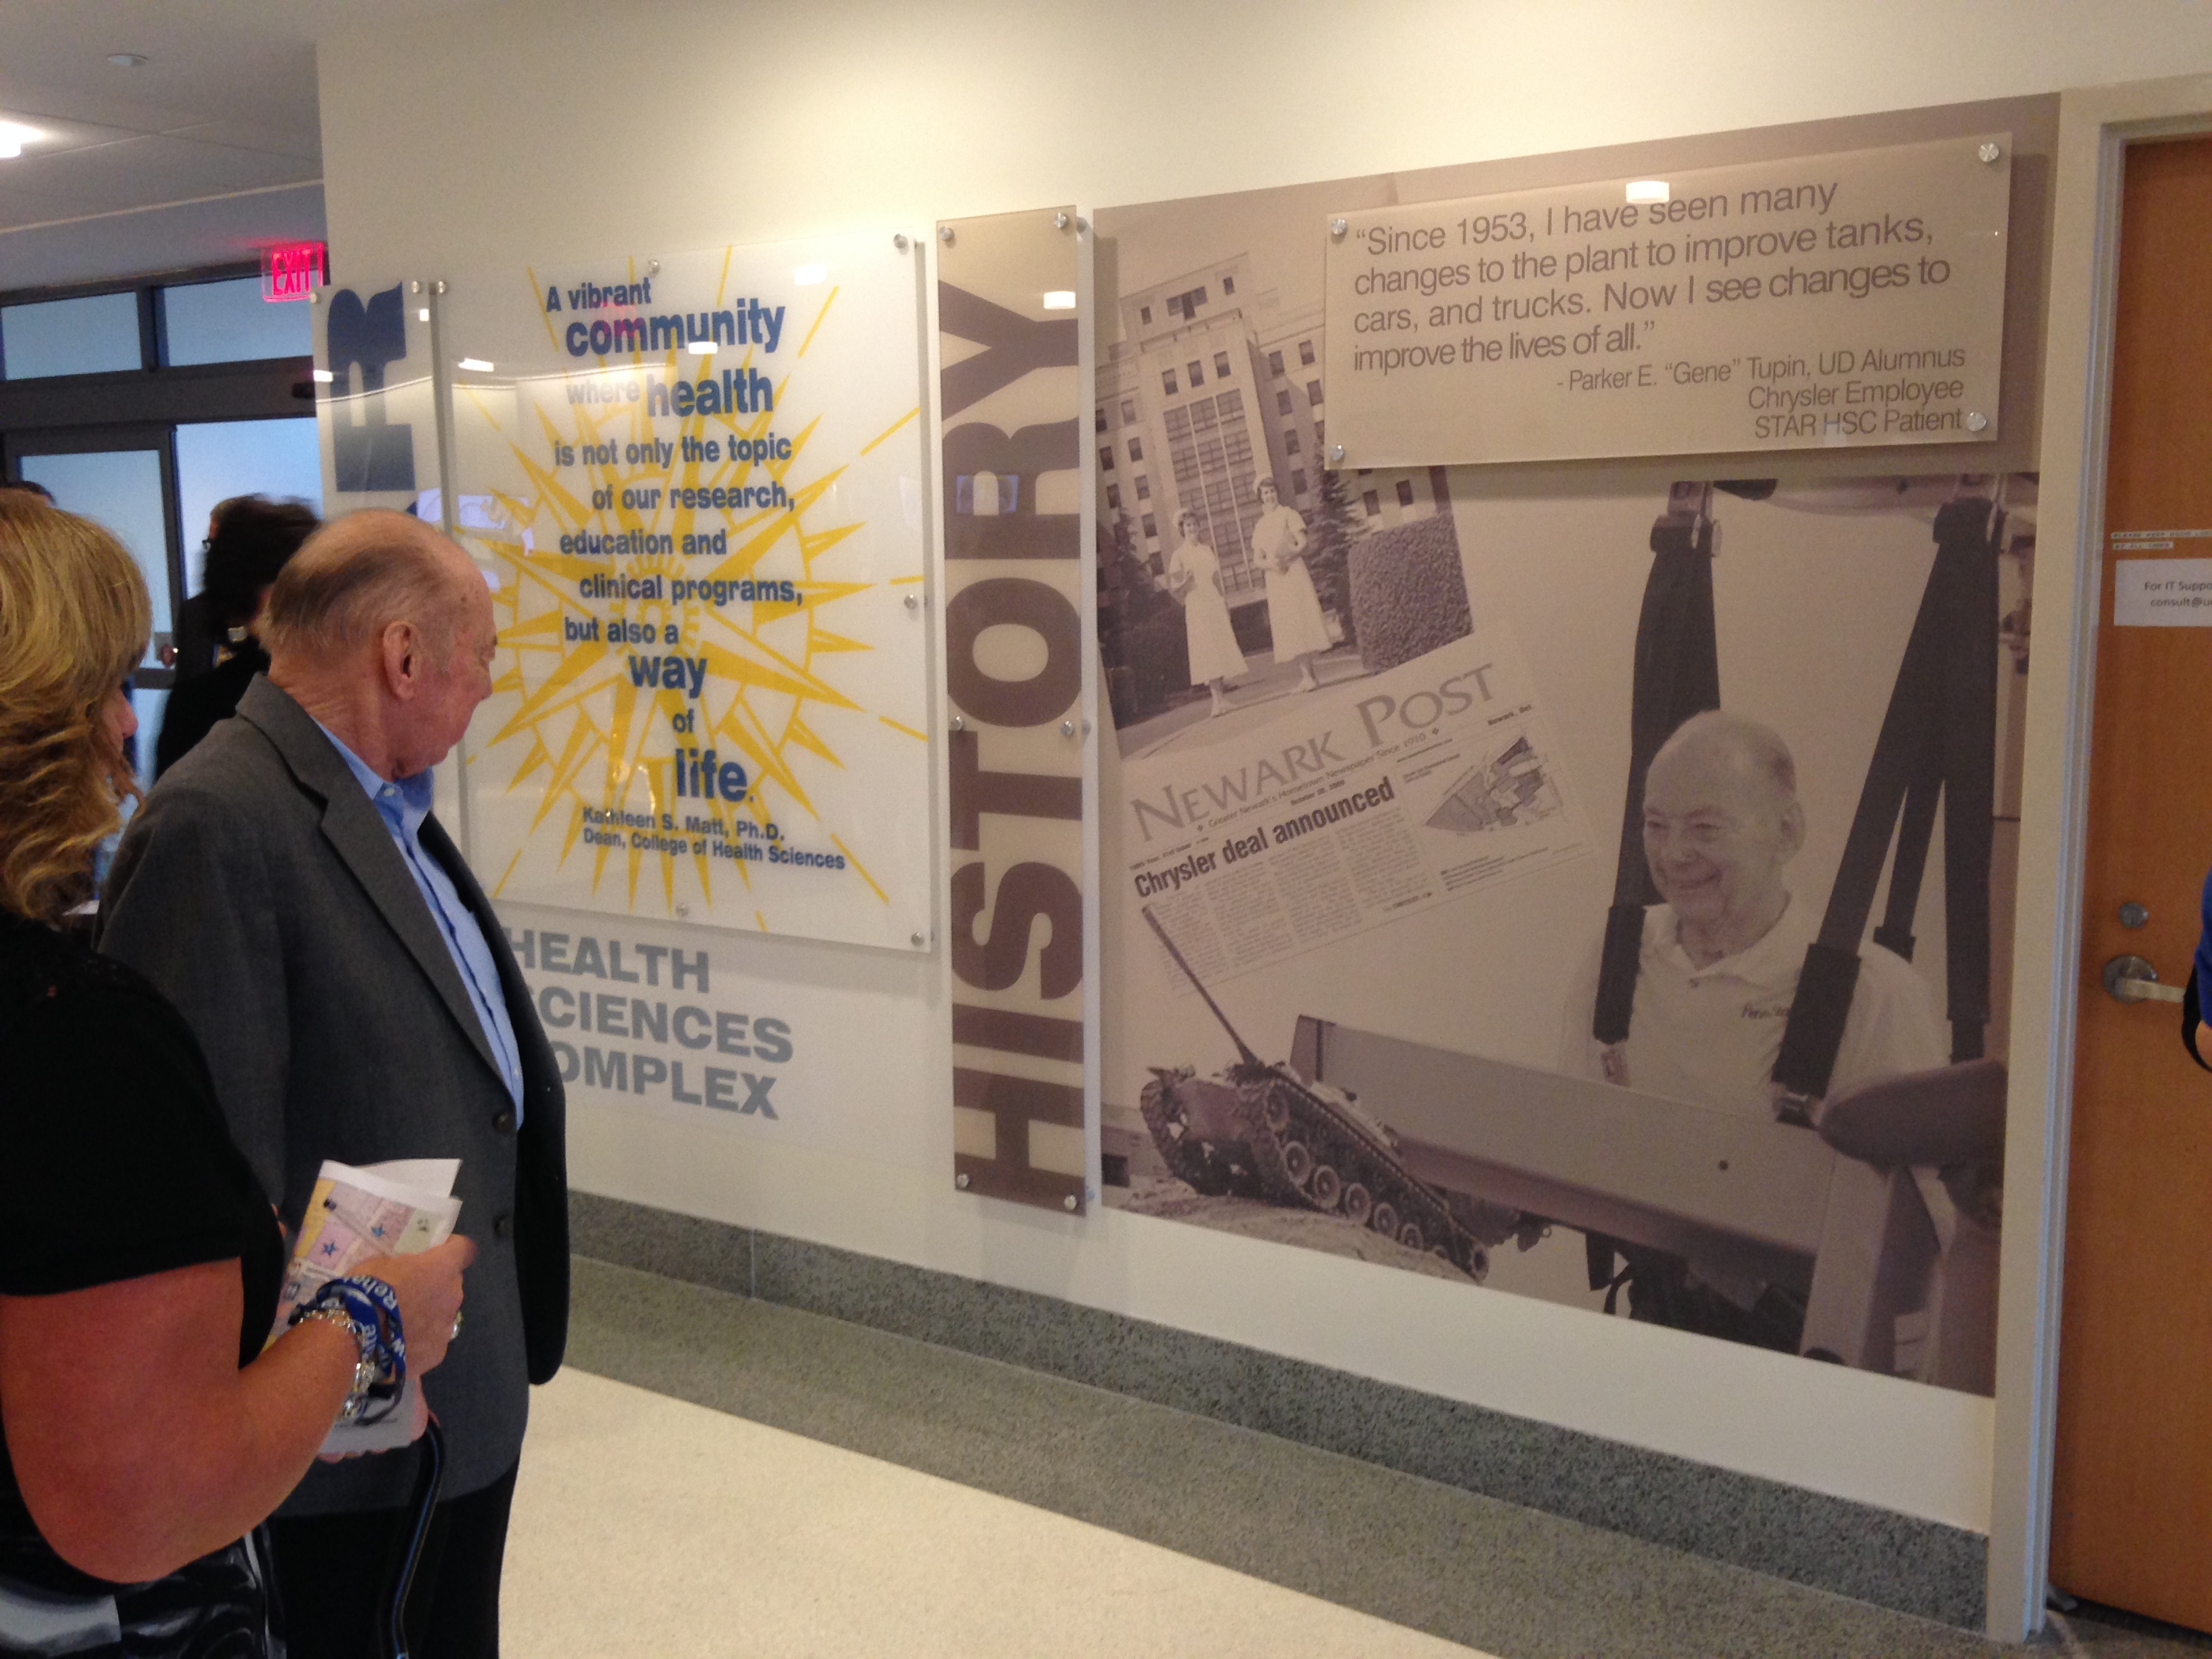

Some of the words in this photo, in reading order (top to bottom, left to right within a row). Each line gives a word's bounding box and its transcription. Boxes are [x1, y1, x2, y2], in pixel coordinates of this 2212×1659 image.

[1356, 226, 1446, 255] “Since
[1458, 211, 1534, 245] 1953,
[1547, 207, 1553, 235] I
[1564, 203, 1639, 234] have
[1649, 194, 1728, 224] seen
[1740, 182, 1839, 216] many
[272, 248, 312, 295] EXIT
[1355, 263, 1470, 296] changes
[1477, 257, 1504, 283] to
[1512, 251, 1557, 279] the
[1566, 241, 1639, 281] plant
[1648, 240, 1675, 266] to
[1685, 228, 1817, 267] improve
[1828, 213, 1933, 249] tanks,
[546, 285, 561, 313] A
[567, 276, 651, 310] vibrant
[1355, 307, 1418, 333] cars,
[1429, 295, 1482, 327] and
[1492, 289, 1591, 322] trucks.
[1604, 282, 1677, 311] Now
[1688, 276, 1695, 304] I
[1706, 275, 1762, 304] see
[1769, 260, 1910, 300] changes
[1919, 255, 1950, 285] to
[566, 298, 786, 357] community
[1354, 342, 1456, 376] improve
[1461, 335, 1502, 363] the
[1509, 331, 1566, 360] lives
[1572, 325, 1601, 356] of
[1605, 321, 1655, 352] all.”
[1570, 368, 1633, 391] Parker
[1638, 364, 1657, 387] E.
[1664, 358, 1740, 385] “Gene”
[1746, 354, 1810, 384] Tupin,
[1819, 350, 1854, 375] UD
[1861, 348, 1965, 373] Alumnus
[566, 375, 639, 406] where
[647, 368, 773, 418] health
[1748, 381, 1839, 413] Chrysler
[1845, 379, 1964, 407] Employee
[1755, 414, 1816, 439] STAR
[1823, 410, 1877, 436] HSC
[1883, 407, 1963, 432] Patient
[555, 440, 574, 466] is
[582, 436, 618, 466] not
[626, 436, 674, 469] only
[681, 434, 719, 462] the
[729, 432, 792, 467] topic
[592, 485, 614, 510] of
[621, 485, 661, 510] our
[670, 480, 796, 512] research,
[559, 528, 673, 555] education
[681, 528, 727, 555] and
[579, 573, 662, 599] clinical
[671, 578, 803, 607] programs,
[2144, 581, 2162, 590] For
[2166, 581, 2174, 590] IT
[565, 617, 600, 642] but
[607, 618, 656, 644] also
[664, 621, 678, 644] a
[628, 654, 708, 699] way
[672, 710, 695, 733] of
[938, 280, 1085, 1214] HISTORY
[1130, 731, 1346, 842] NEWARK
[1355, 663, 1493, 747] POST
[676, 748, 754, 803] life.
[582, 806, 656, 831] Kathleen
[662, 813, 678, 832] S.
[685, 816, 729, 838] Matt,
[736, 820, 785, 841] Ph.D.
[1135, 852, 1216, 897] Chrysler
[1223, 827, 1269, 864] deal
[1273, 776, 1395, 844] announced
[583, 828, 626, 849] Dean,
[631, 833, 687, 856] College
[692, 838, 707, 856] of
[712, 839, 762, 862] Health
[768, 846, 845, 869] Sciences
[503, 926, 710, 994] HEALTH
[528, 985, 794, 1063] CIENCES
[550, 1040, 780, 1120] OMPLEX
[344, 1275, 398, 1311] Reha
